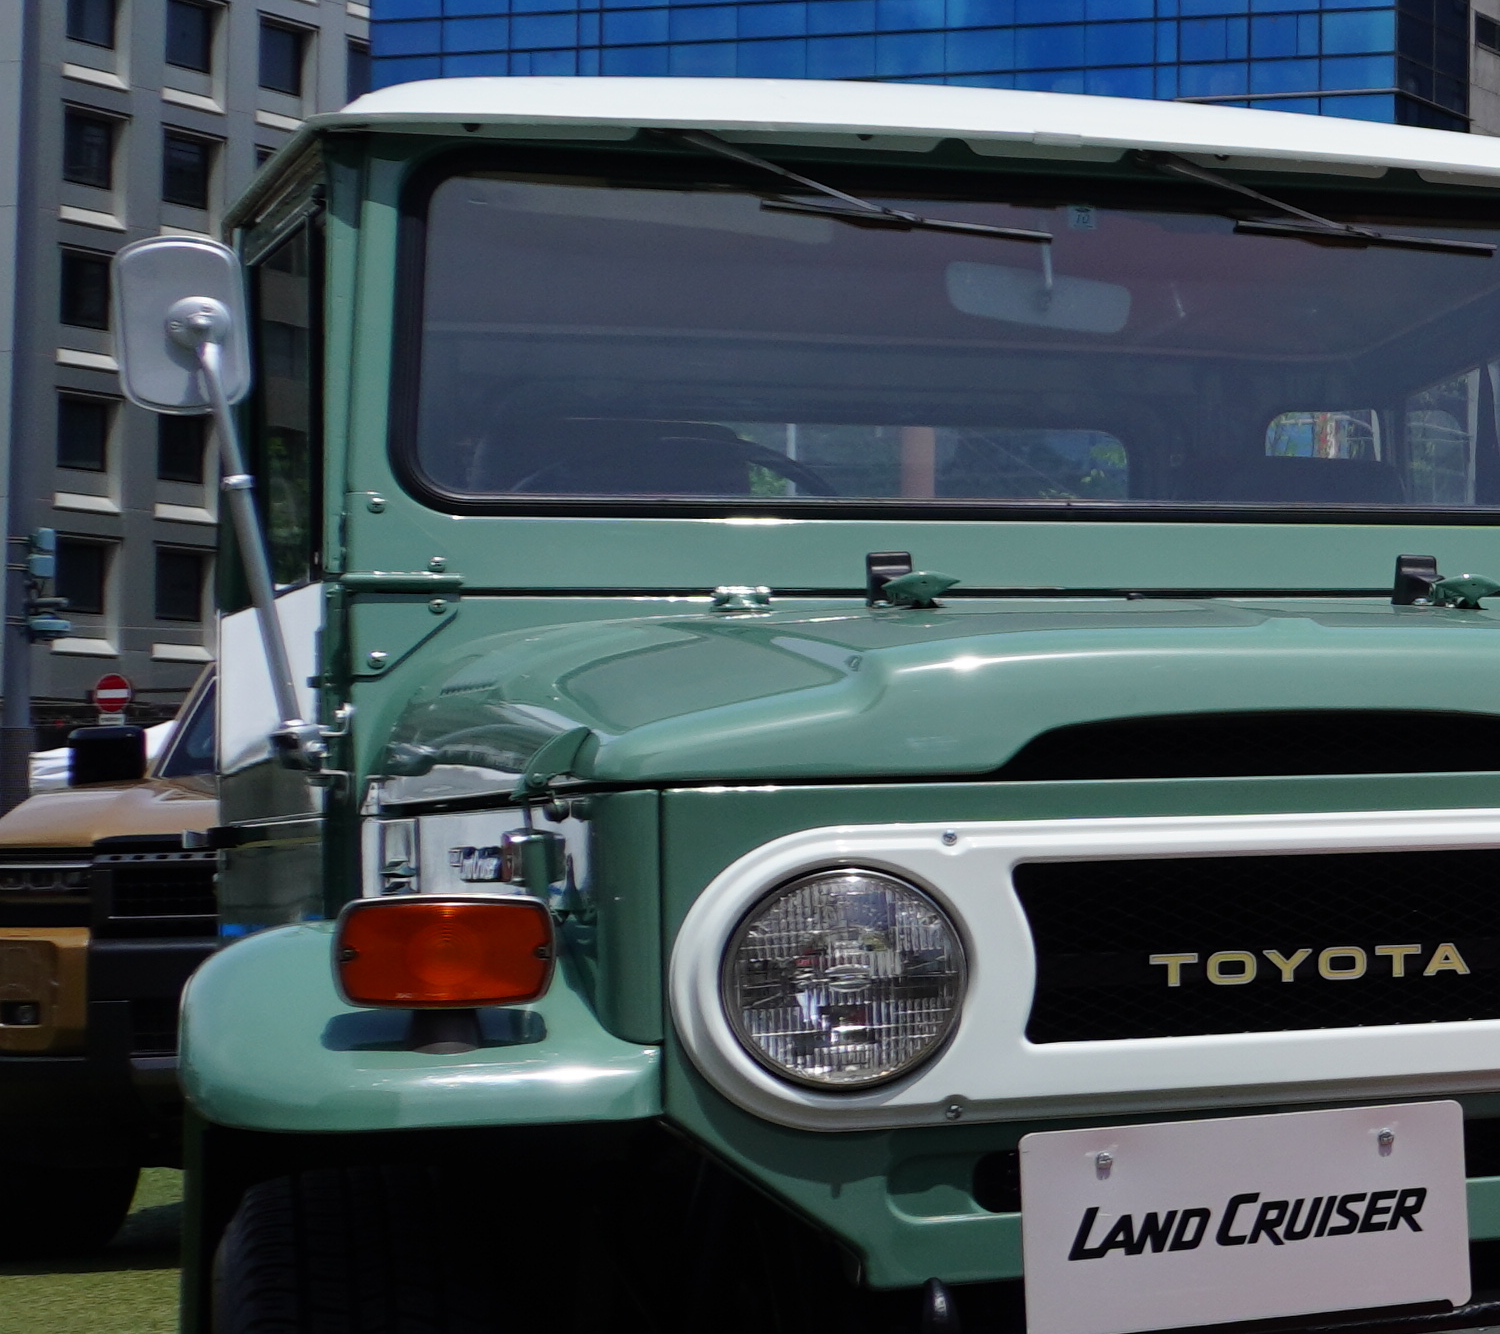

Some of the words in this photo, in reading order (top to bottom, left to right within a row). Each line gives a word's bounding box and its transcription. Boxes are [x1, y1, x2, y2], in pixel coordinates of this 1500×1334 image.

[1148, 942, 1472, 988] TOYOTA
[1067, 1206, 1212, 1262] LAND
[1215, 1186, 1428, 1247] CRUISER
